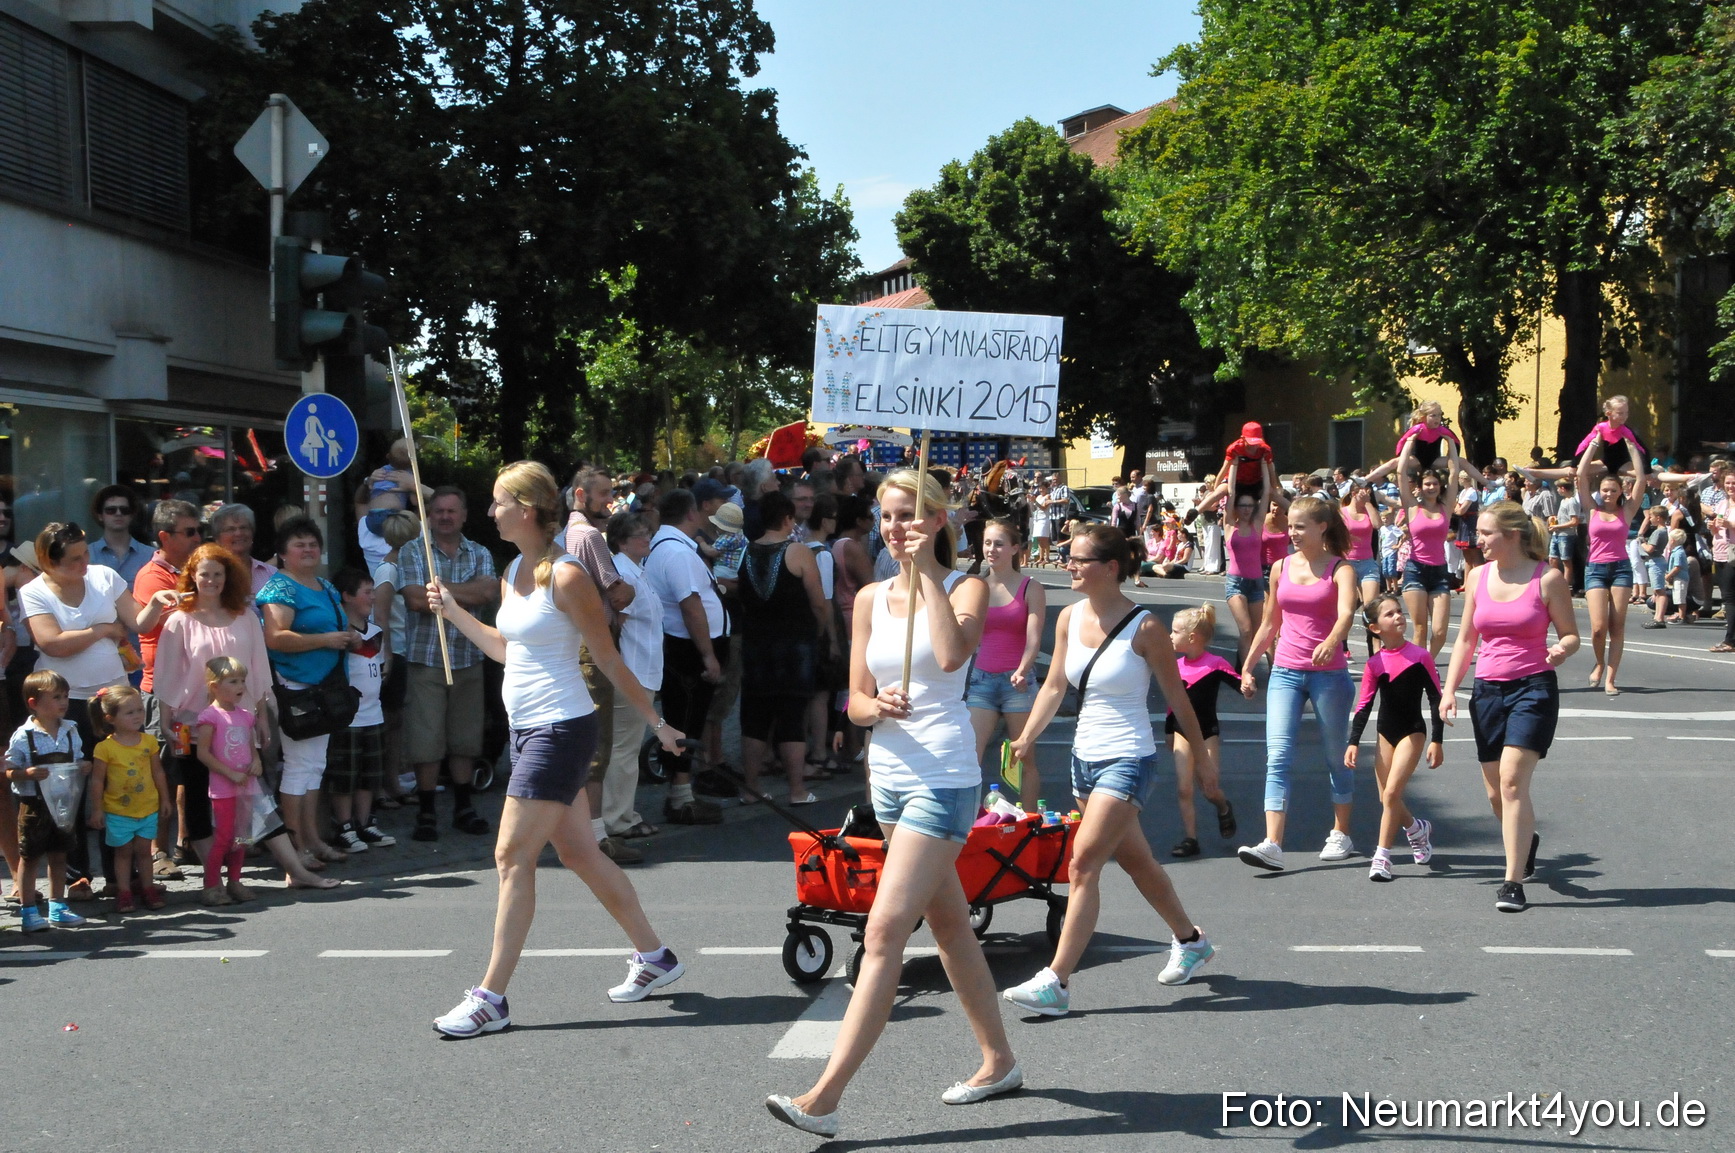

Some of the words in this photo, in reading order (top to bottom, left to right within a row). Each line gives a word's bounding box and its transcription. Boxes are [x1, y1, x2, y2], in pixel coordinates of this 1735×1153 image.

[817, 310, 1062, 364] WELTGYMNASTRADA
[968, 380, 1056, 424] 2015
[368, 663, 378, 678] 13
